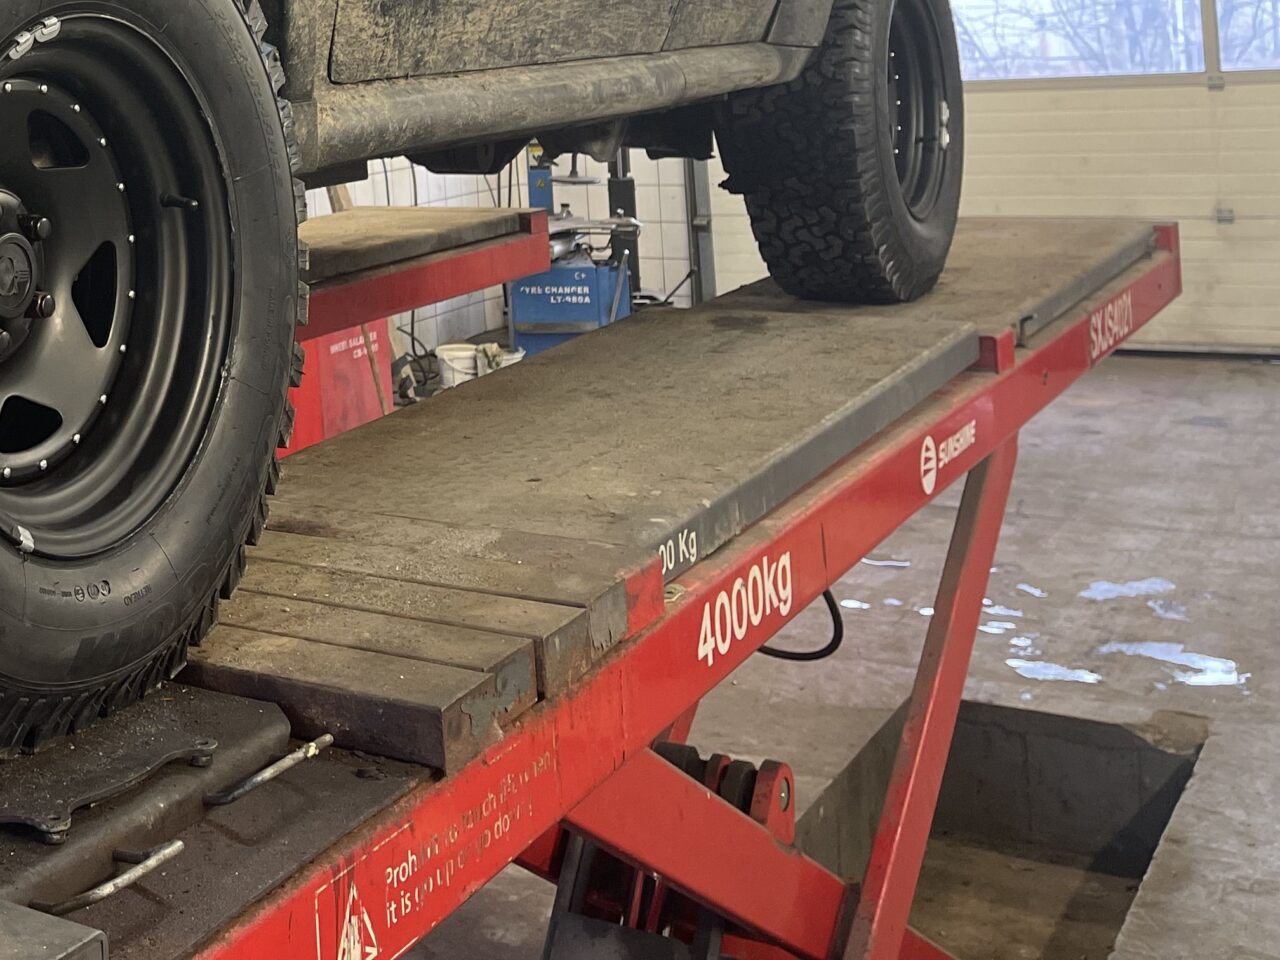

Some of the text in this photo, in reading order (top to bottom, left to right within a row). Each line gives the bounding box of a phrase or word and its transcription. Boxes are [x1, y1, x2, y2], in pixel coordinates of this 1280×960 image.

[938, 419, 976, 469] SUNSHINE
[678, 528, 697, 563] Kg
[697, 551, 792, 667] 4000kg
[386, 901, 398, 928] it
[401, 890, 412, 916] is
